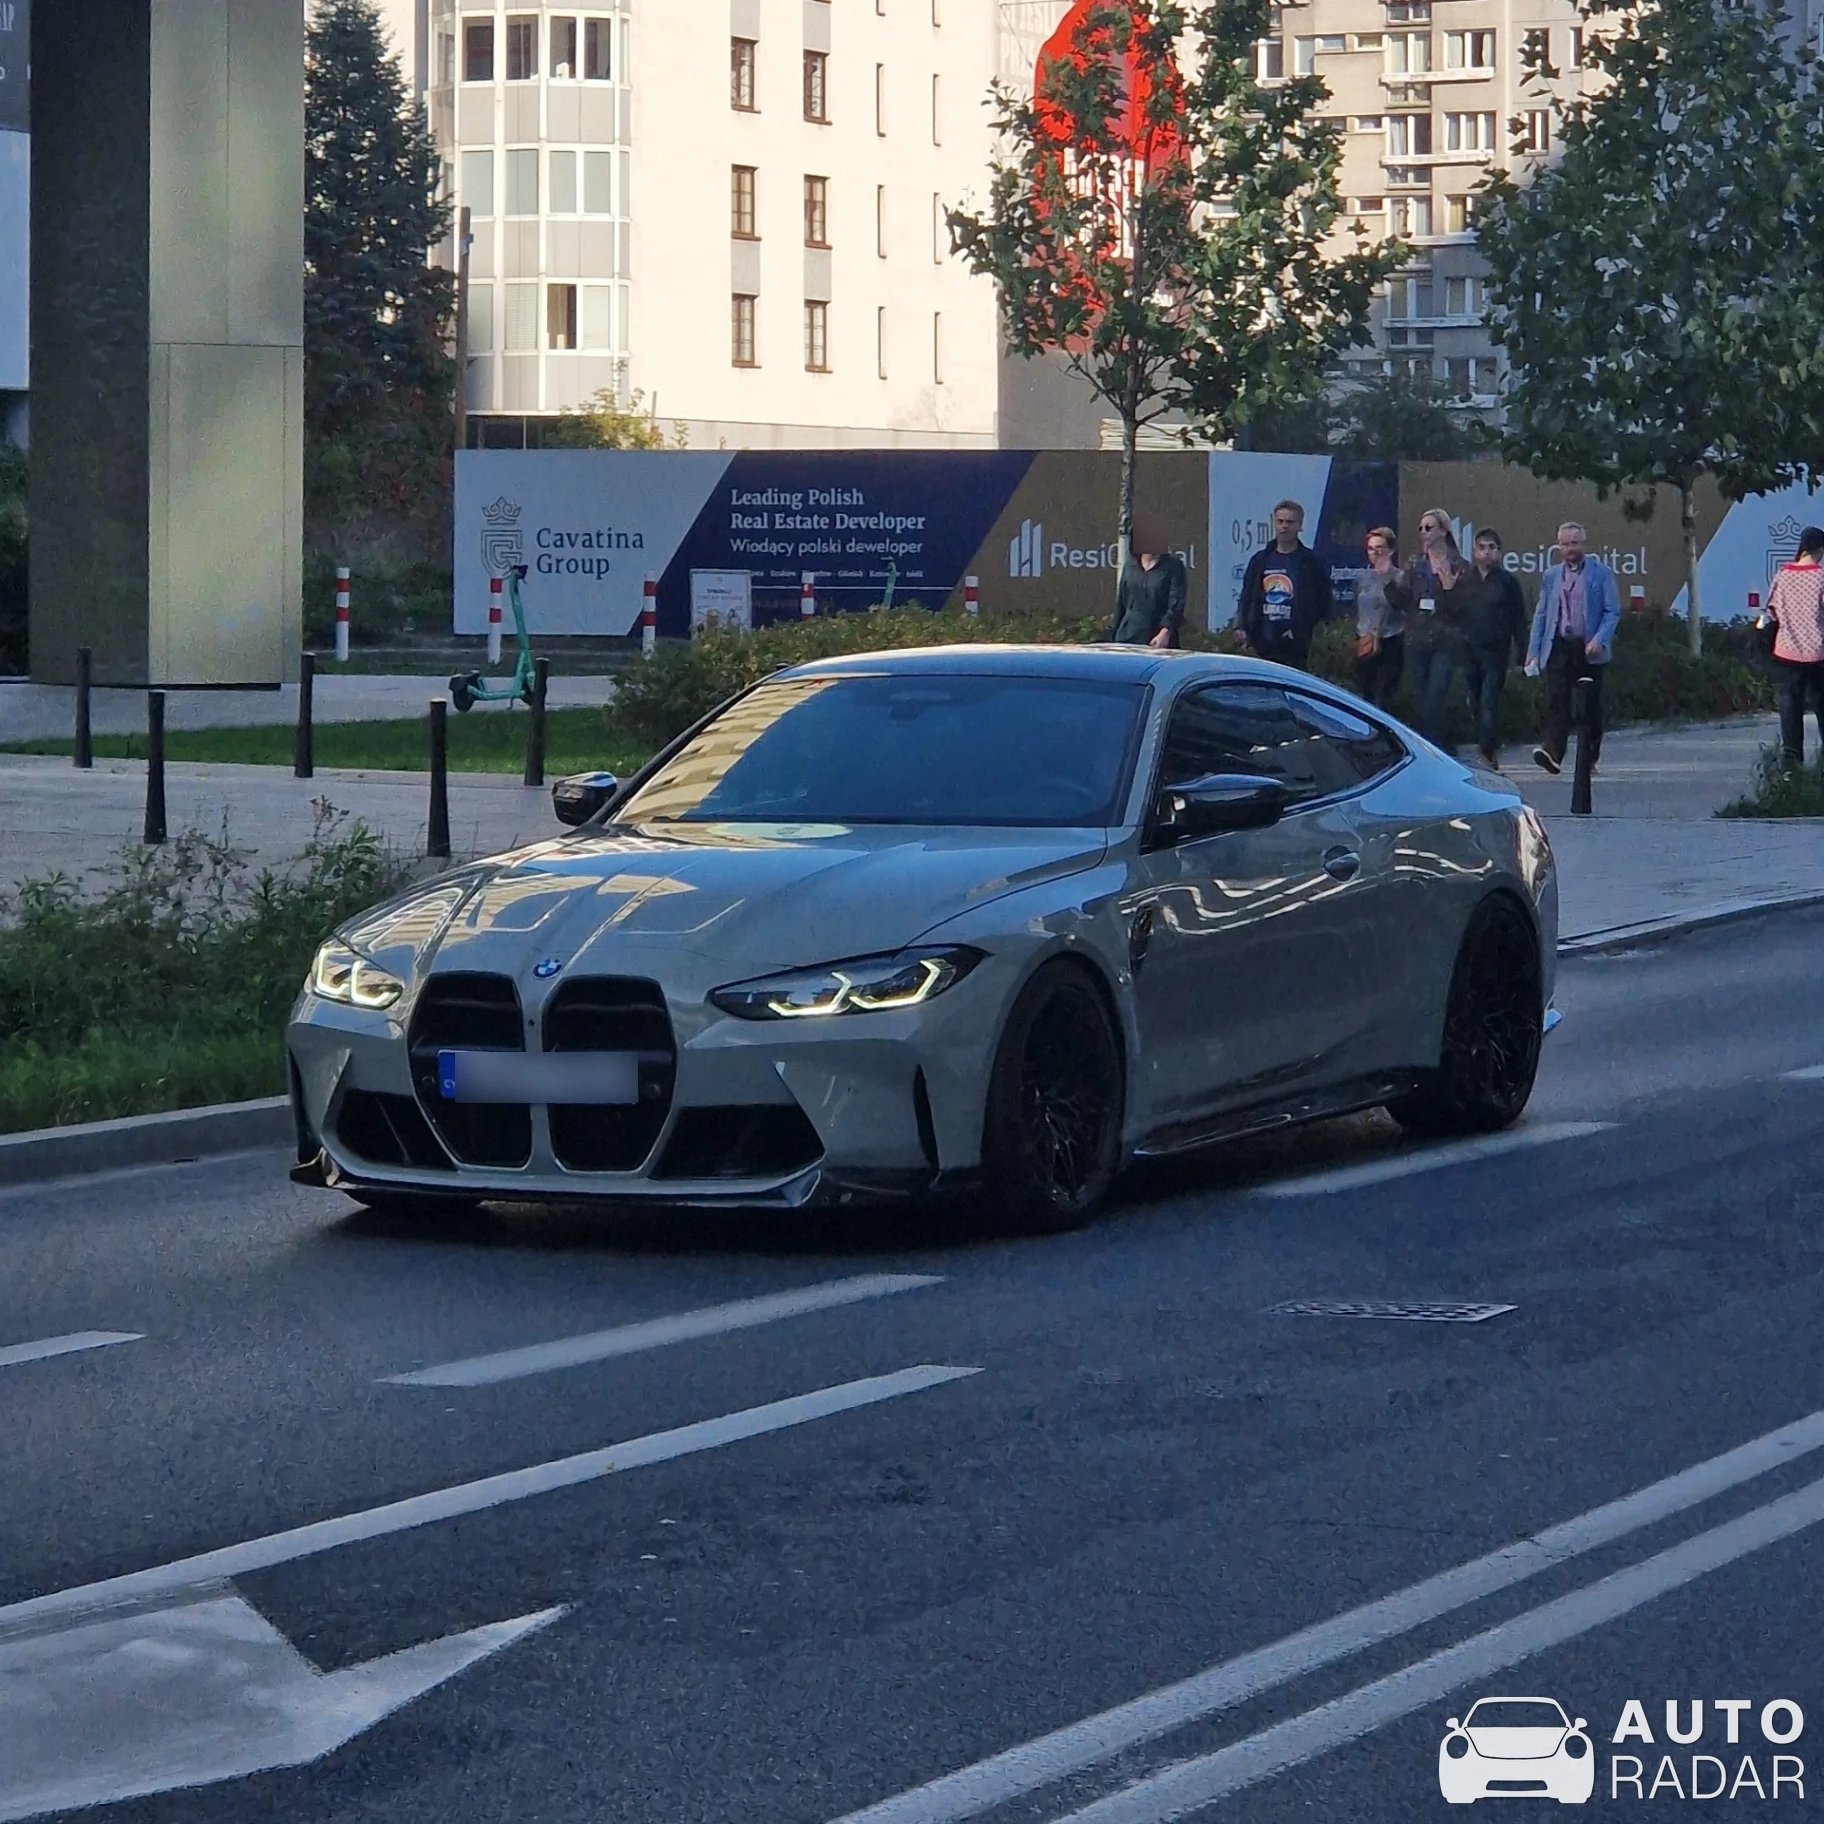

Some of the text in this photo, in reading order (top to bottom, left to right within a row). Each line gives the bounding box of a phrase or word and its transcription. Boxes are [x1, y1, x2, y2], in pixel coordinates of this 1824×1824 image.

[731, 488, 864, 510] Leading Polish
[730, 511, 926, 534] Real Estate Developer
[536, 527, 645, 549] Cavatina
[1232, 519, 1252, 553] 0,5
[730, 538, 923, 557] Wiodący polski deweloper
[536, 553, 610, 580] Group
